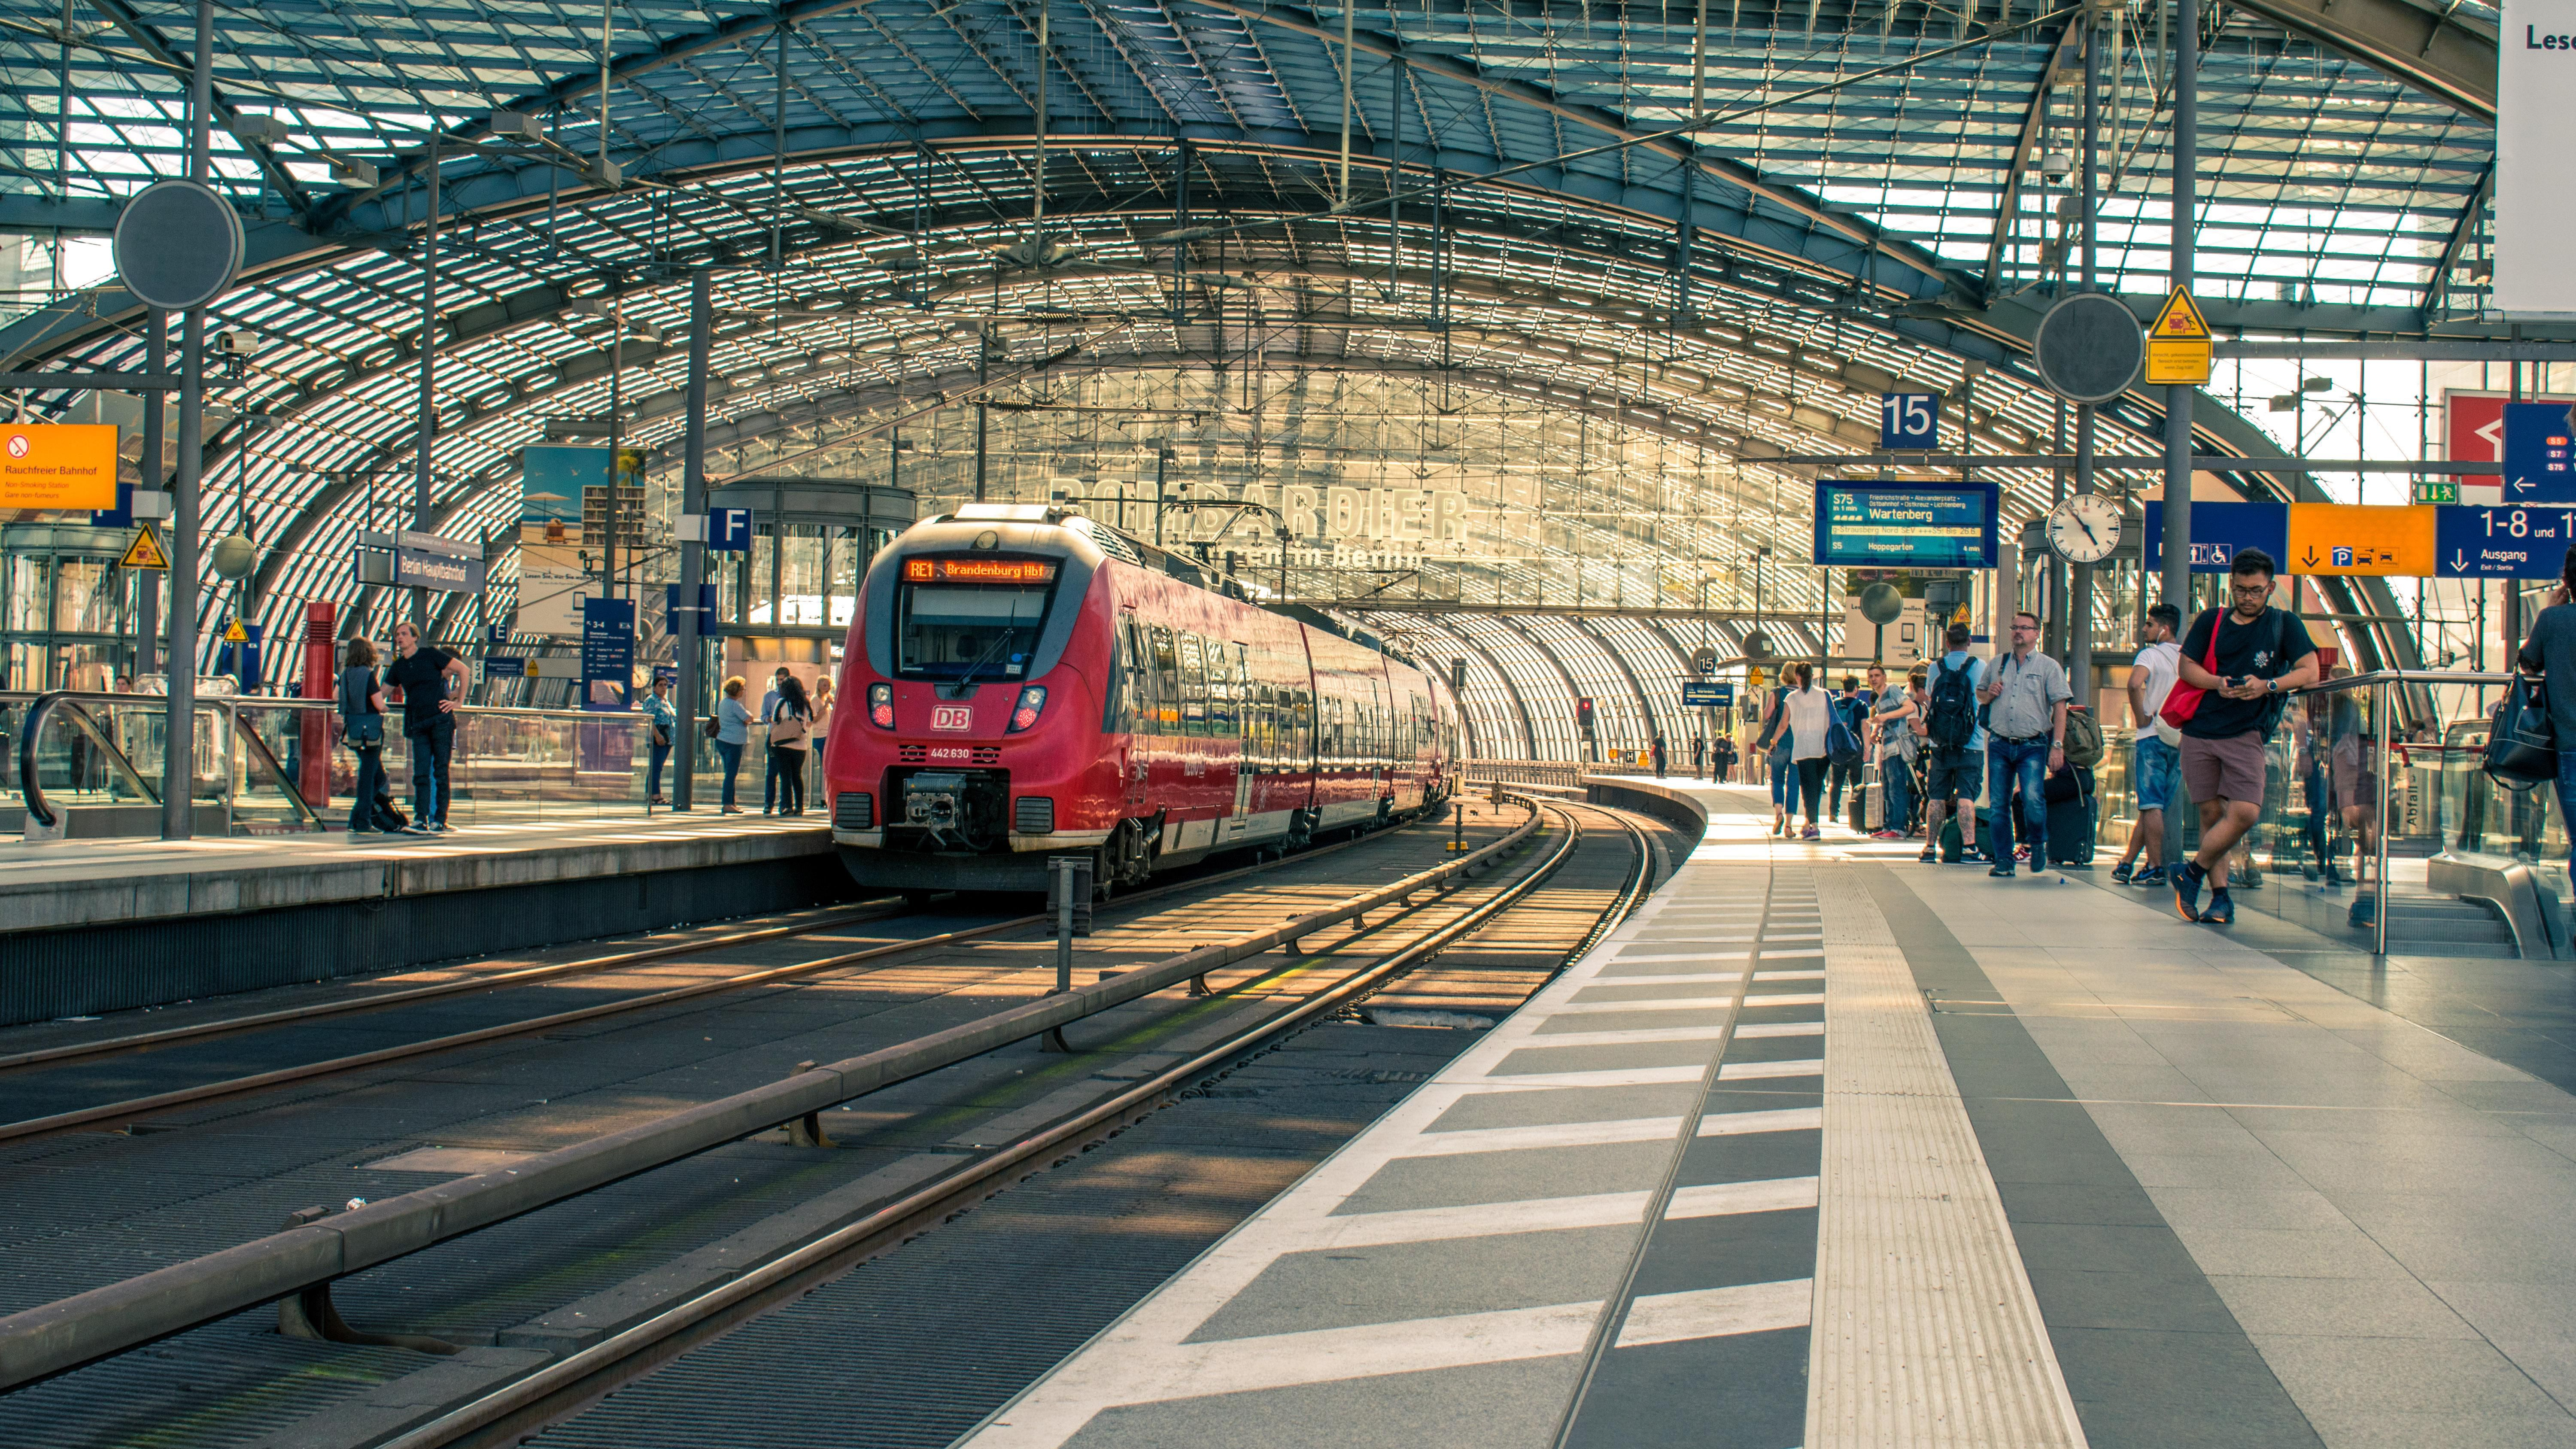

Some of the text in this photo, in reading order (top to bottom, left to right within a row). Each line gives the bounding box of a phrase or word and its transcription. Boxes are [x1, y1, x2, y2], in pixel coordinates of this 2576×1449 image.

[1884, 396, 1930, 435] 15
[5, 465, 97, 475] Rauchfreier Bahnhof
[1833, 494, 1853, 504] S75
[1050, 478, 1468, 543] BOMBARDIER
[1869, 508, 1932, 522] Wartenberg
[726, 510, 746, 541] F
[2481, 510, 2576, 538] 1-8 und 1
[1868, 543, 1914, 552] Hoppegarten
[1334, 543, 1422, 568] Berlin
[2481, 549, 2527, 562] Ausgang
[401, 556, 467, 582] Berlin Hauptbahnhof
[911, 562, 1043, 577] RE1 Brandenburg Hbf
[496, 625, 505, 638] E
[1700, 658, 1713, 669] 15
[935, 709, 967, 727] DB
[931, 748, 969, 758] 442.630
[1628, 753, 1633, 761] H
[2406, 786, 2418, 826] Abfall
